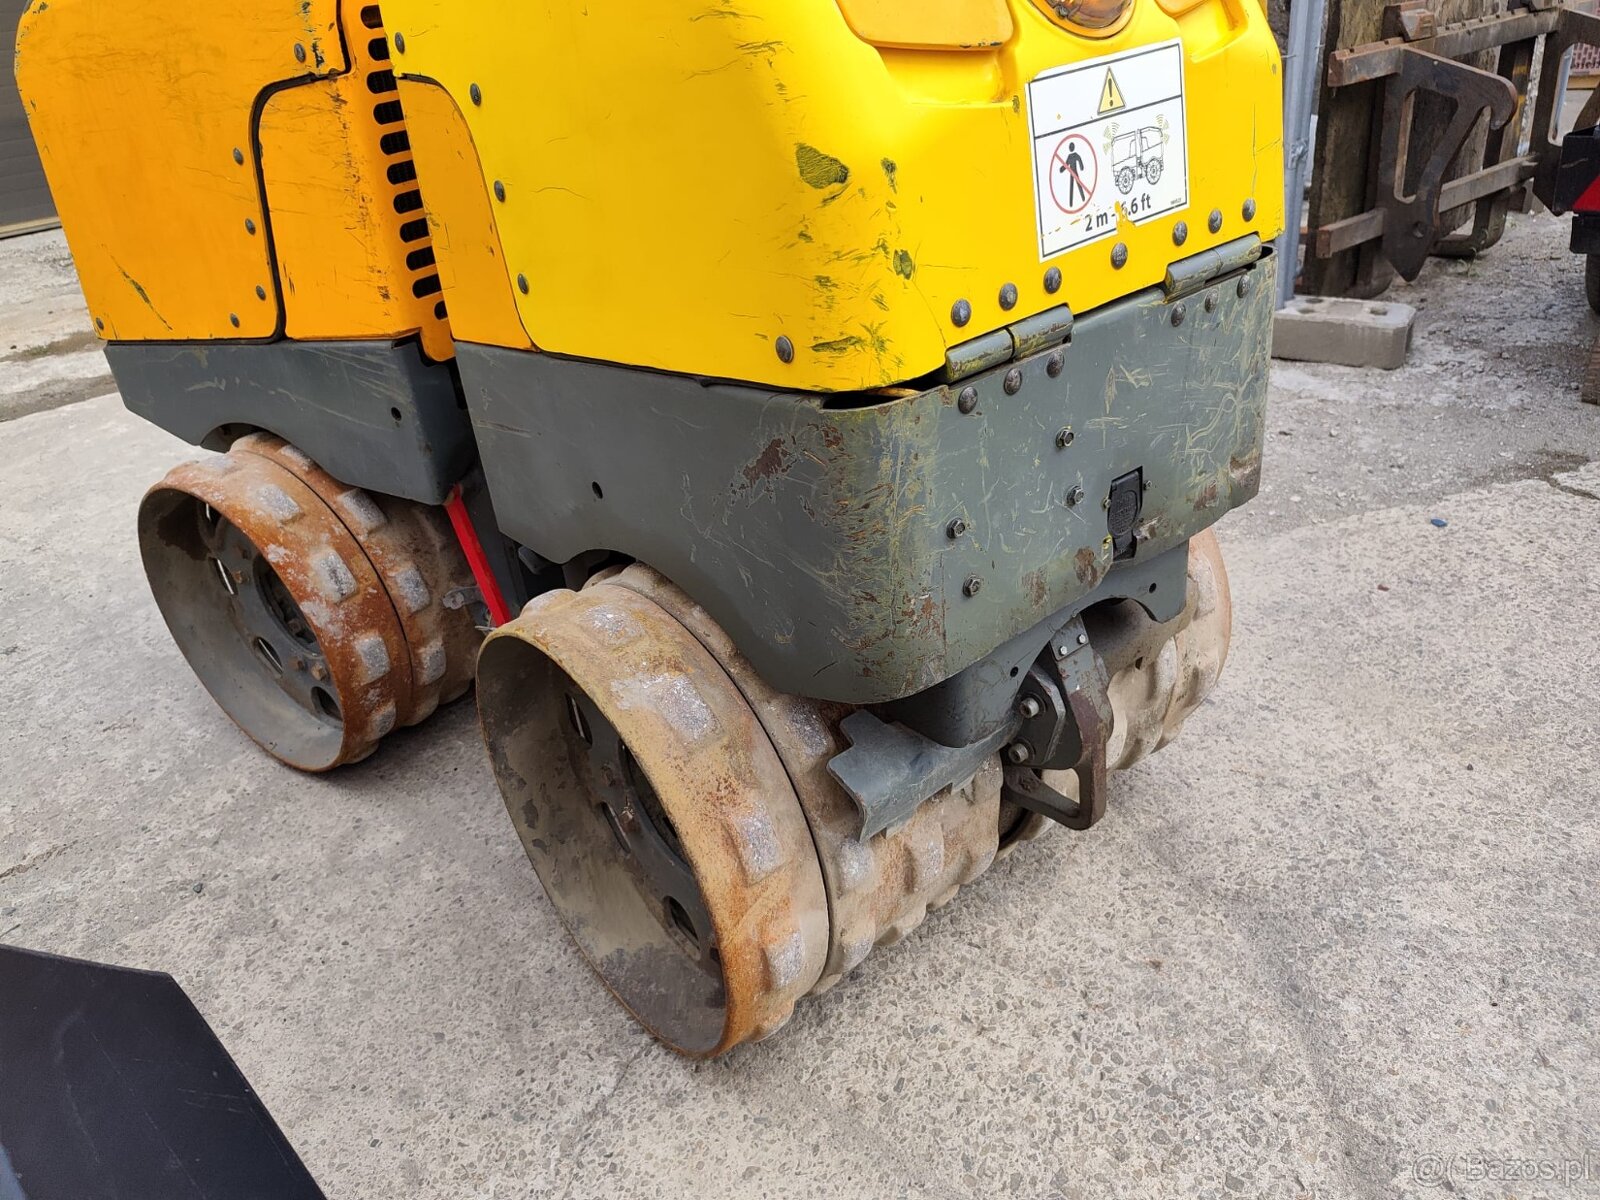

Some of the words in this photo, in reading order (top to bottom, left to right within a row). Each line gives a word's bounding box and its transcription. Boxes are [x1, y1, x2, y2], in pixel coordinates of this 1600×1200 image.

[1084, 213, 1093, 233] 2
[1096, 212, 1108, 228] m
[1141, 193, 1152, 211] ft
